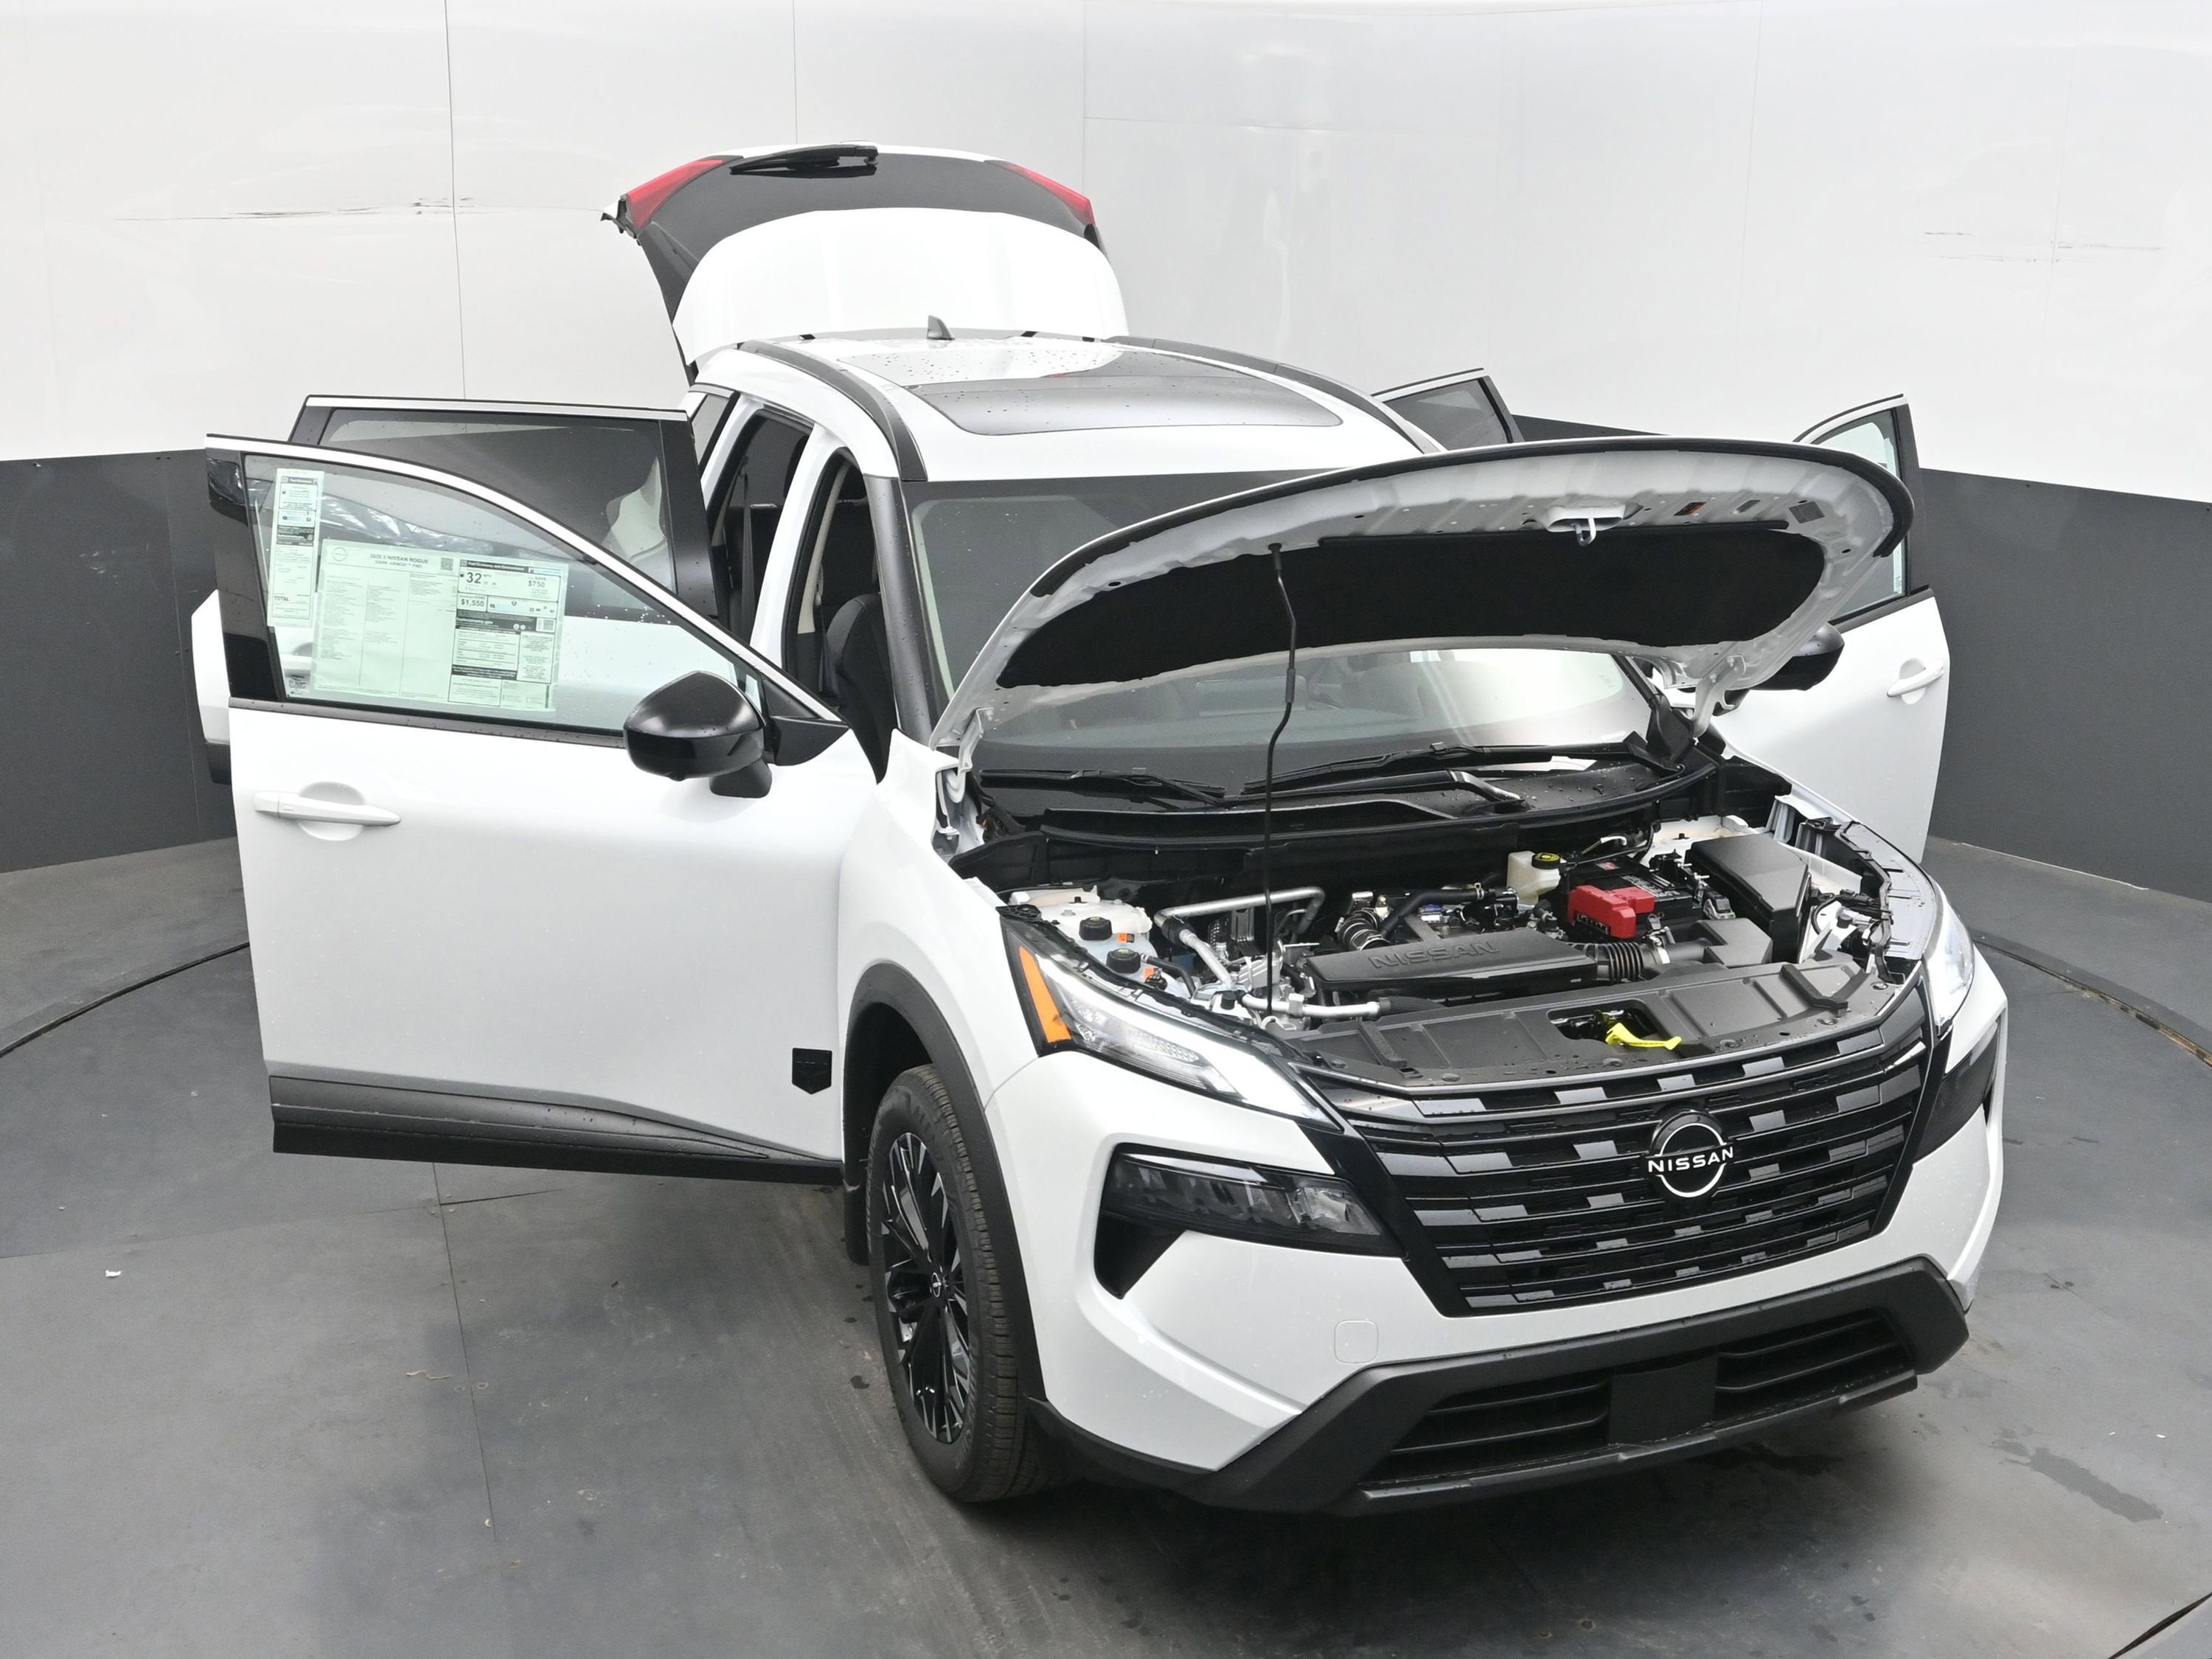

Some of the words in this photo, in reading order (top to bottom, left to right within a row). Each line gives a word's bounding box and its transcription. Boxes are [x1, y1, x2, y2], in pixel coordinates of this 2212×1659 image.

[466, 571, 482, 584] 32
[461, 598, 485, 607] $1,550
[1368, 941, 1500, 969] NISSAN
[1647, 1146, 1734, 1174] NISSAN
